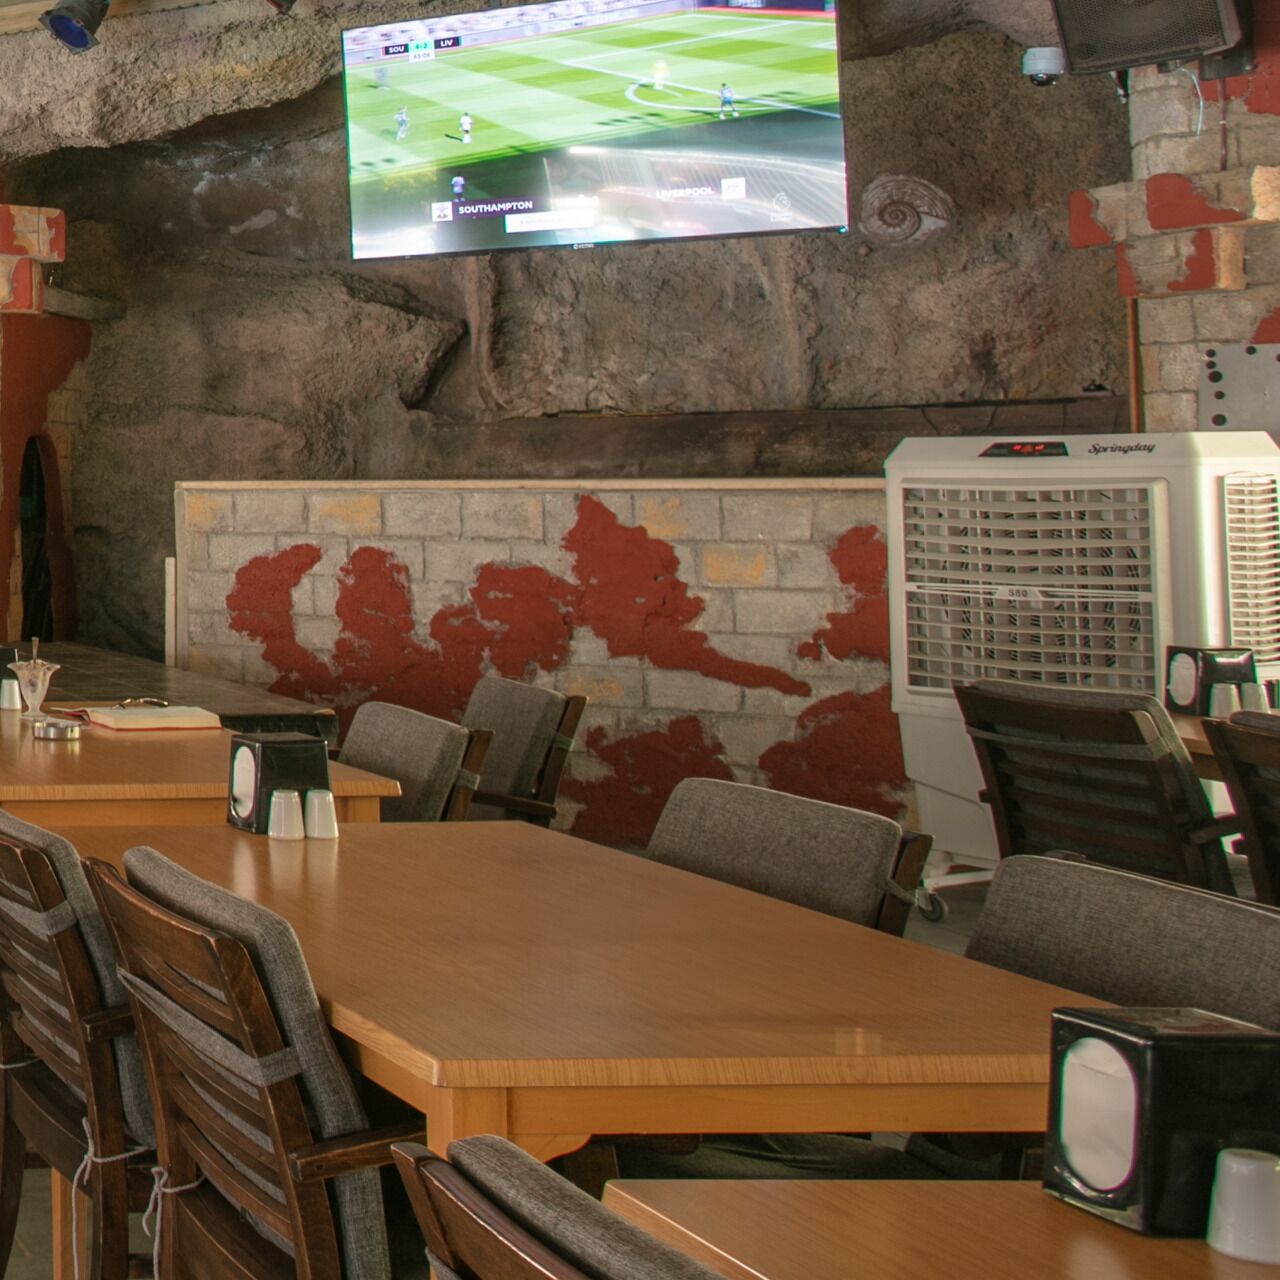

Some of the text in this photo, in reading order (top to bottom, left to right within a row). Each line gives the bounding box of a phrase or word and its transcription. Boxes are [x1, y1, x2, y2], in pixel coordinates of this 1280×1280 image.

[388, 46, 405, 54] SOU
[440, 39, 454, 47] LIV
[655, 186, 715, 200] LIVERPOOL
[458, 200, 534, 215] SOUTHAMPTON
[1087, 442, 1157, 456] Springday
